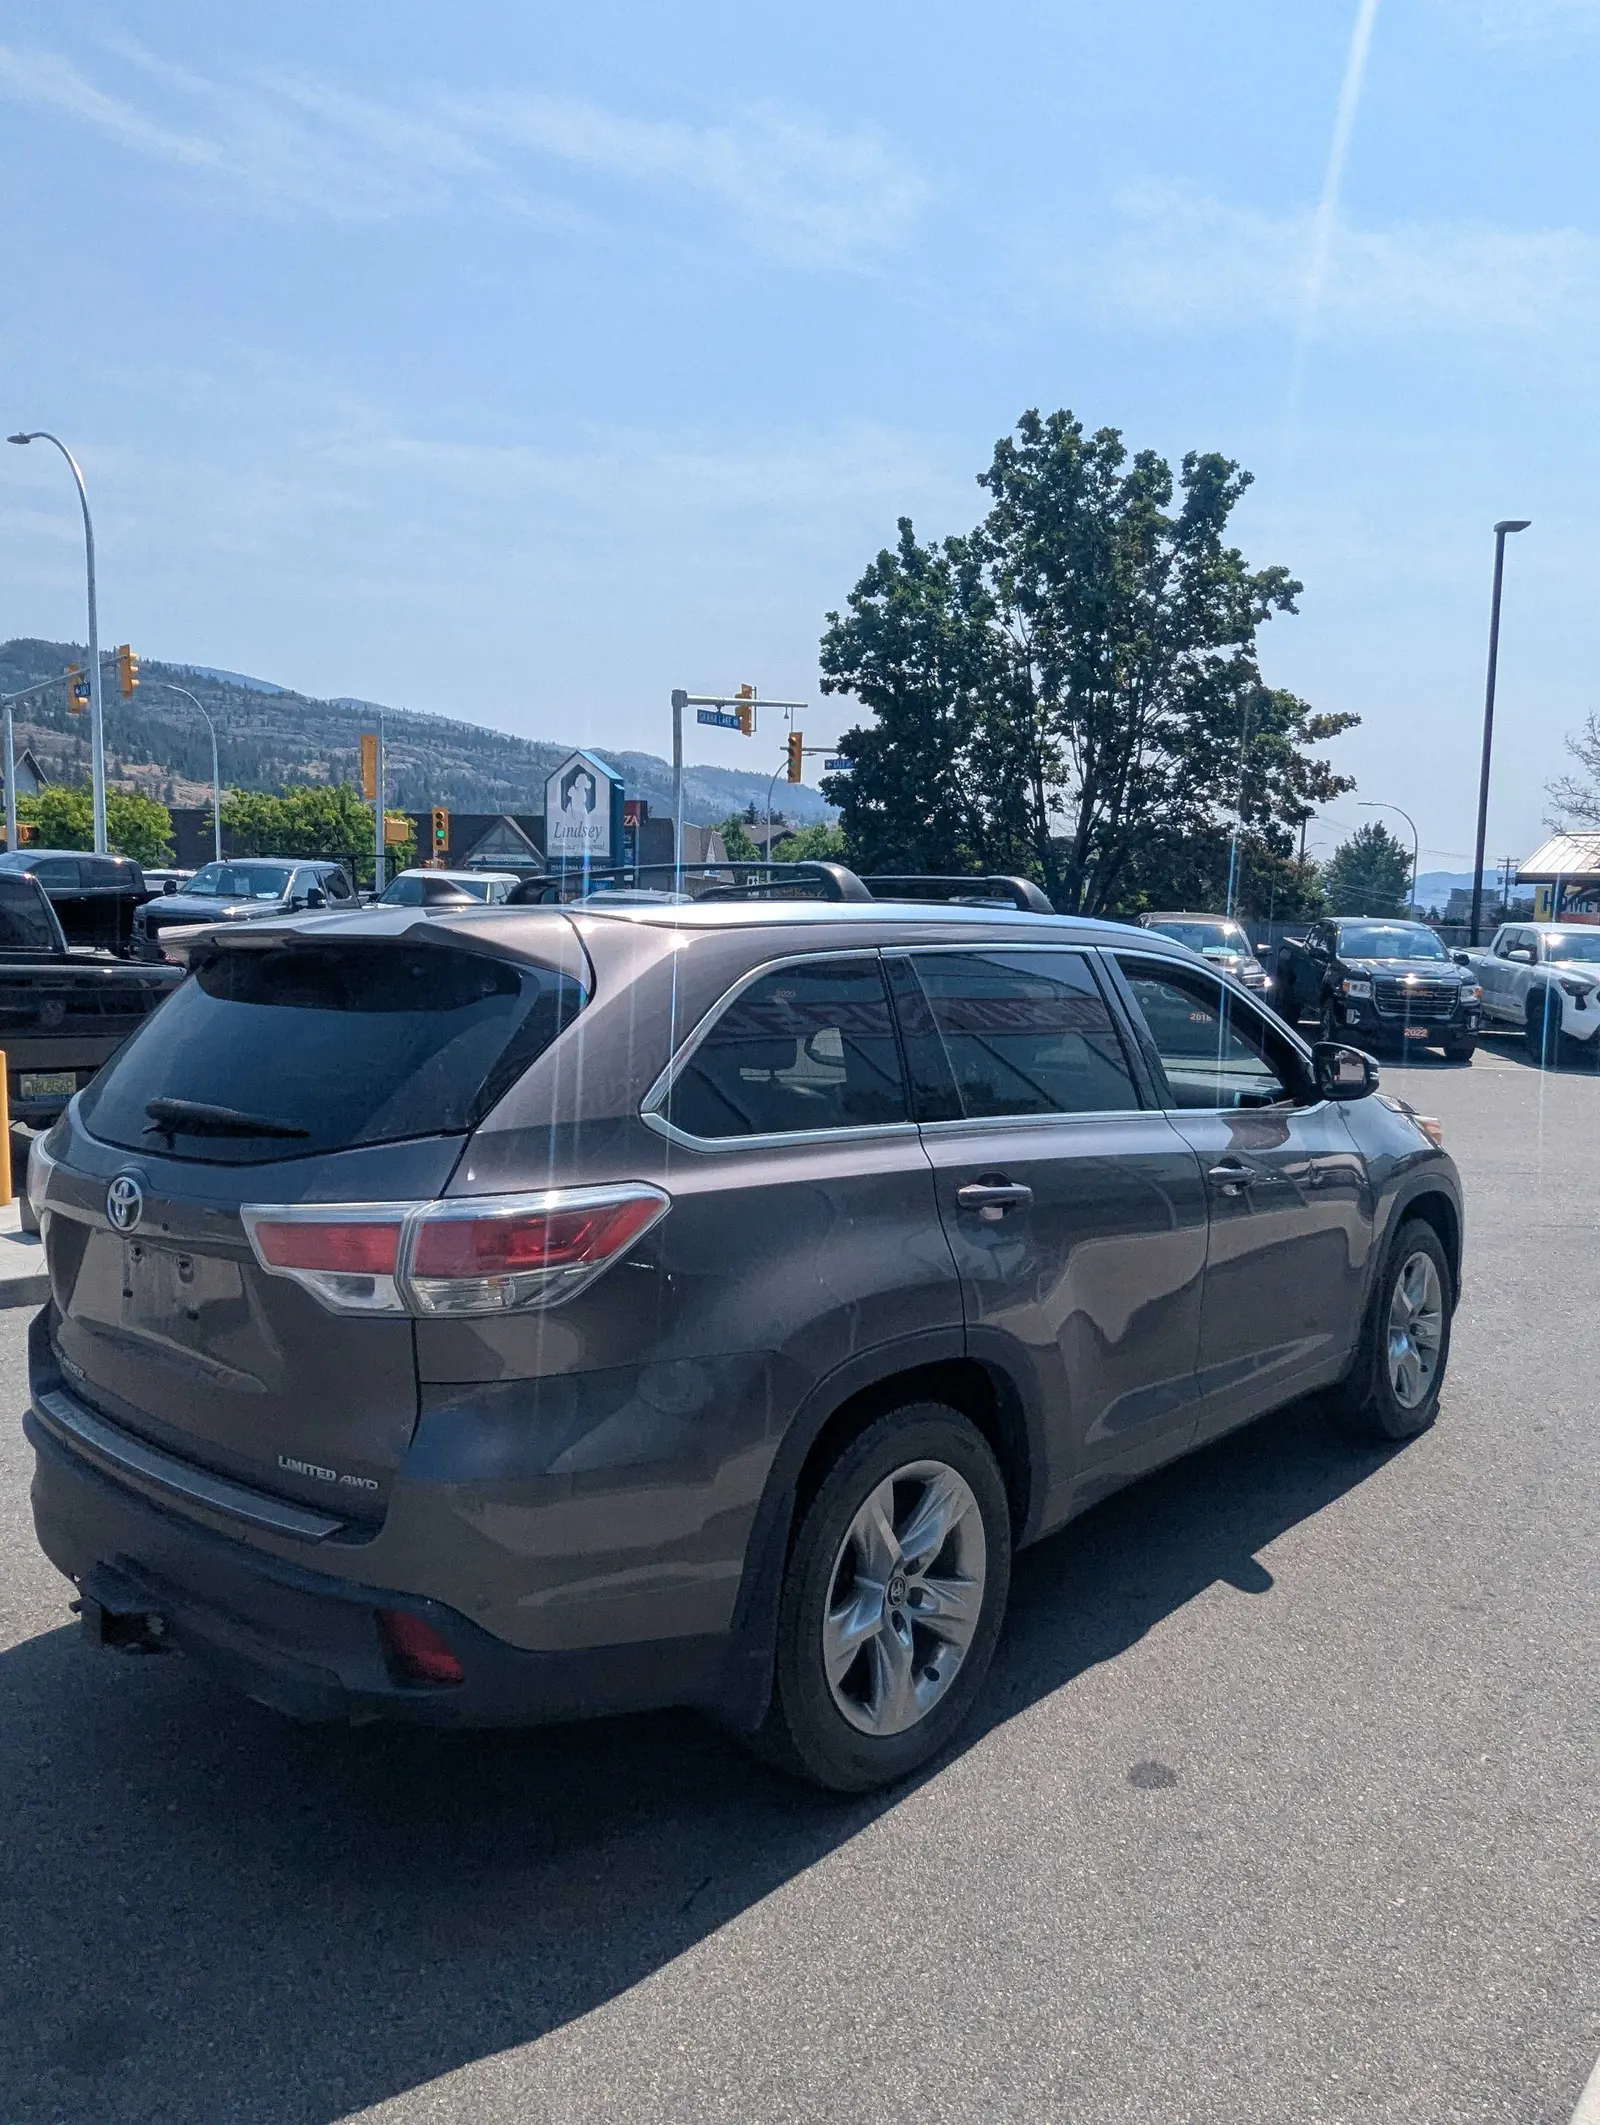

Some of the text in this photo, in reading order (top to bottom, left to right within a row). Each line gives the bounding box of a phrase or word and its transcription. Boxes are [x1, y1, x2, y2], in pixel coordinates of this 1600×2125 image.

[699, 711, 718, 723] SKAHA
[718, 715, 732, 727] LAKE
[553, 821, 604, 841] Lindsey
[1404, 1028, 1427, 1037] 2022
[278, 1455, 379, 1490] LIMITED AWD
